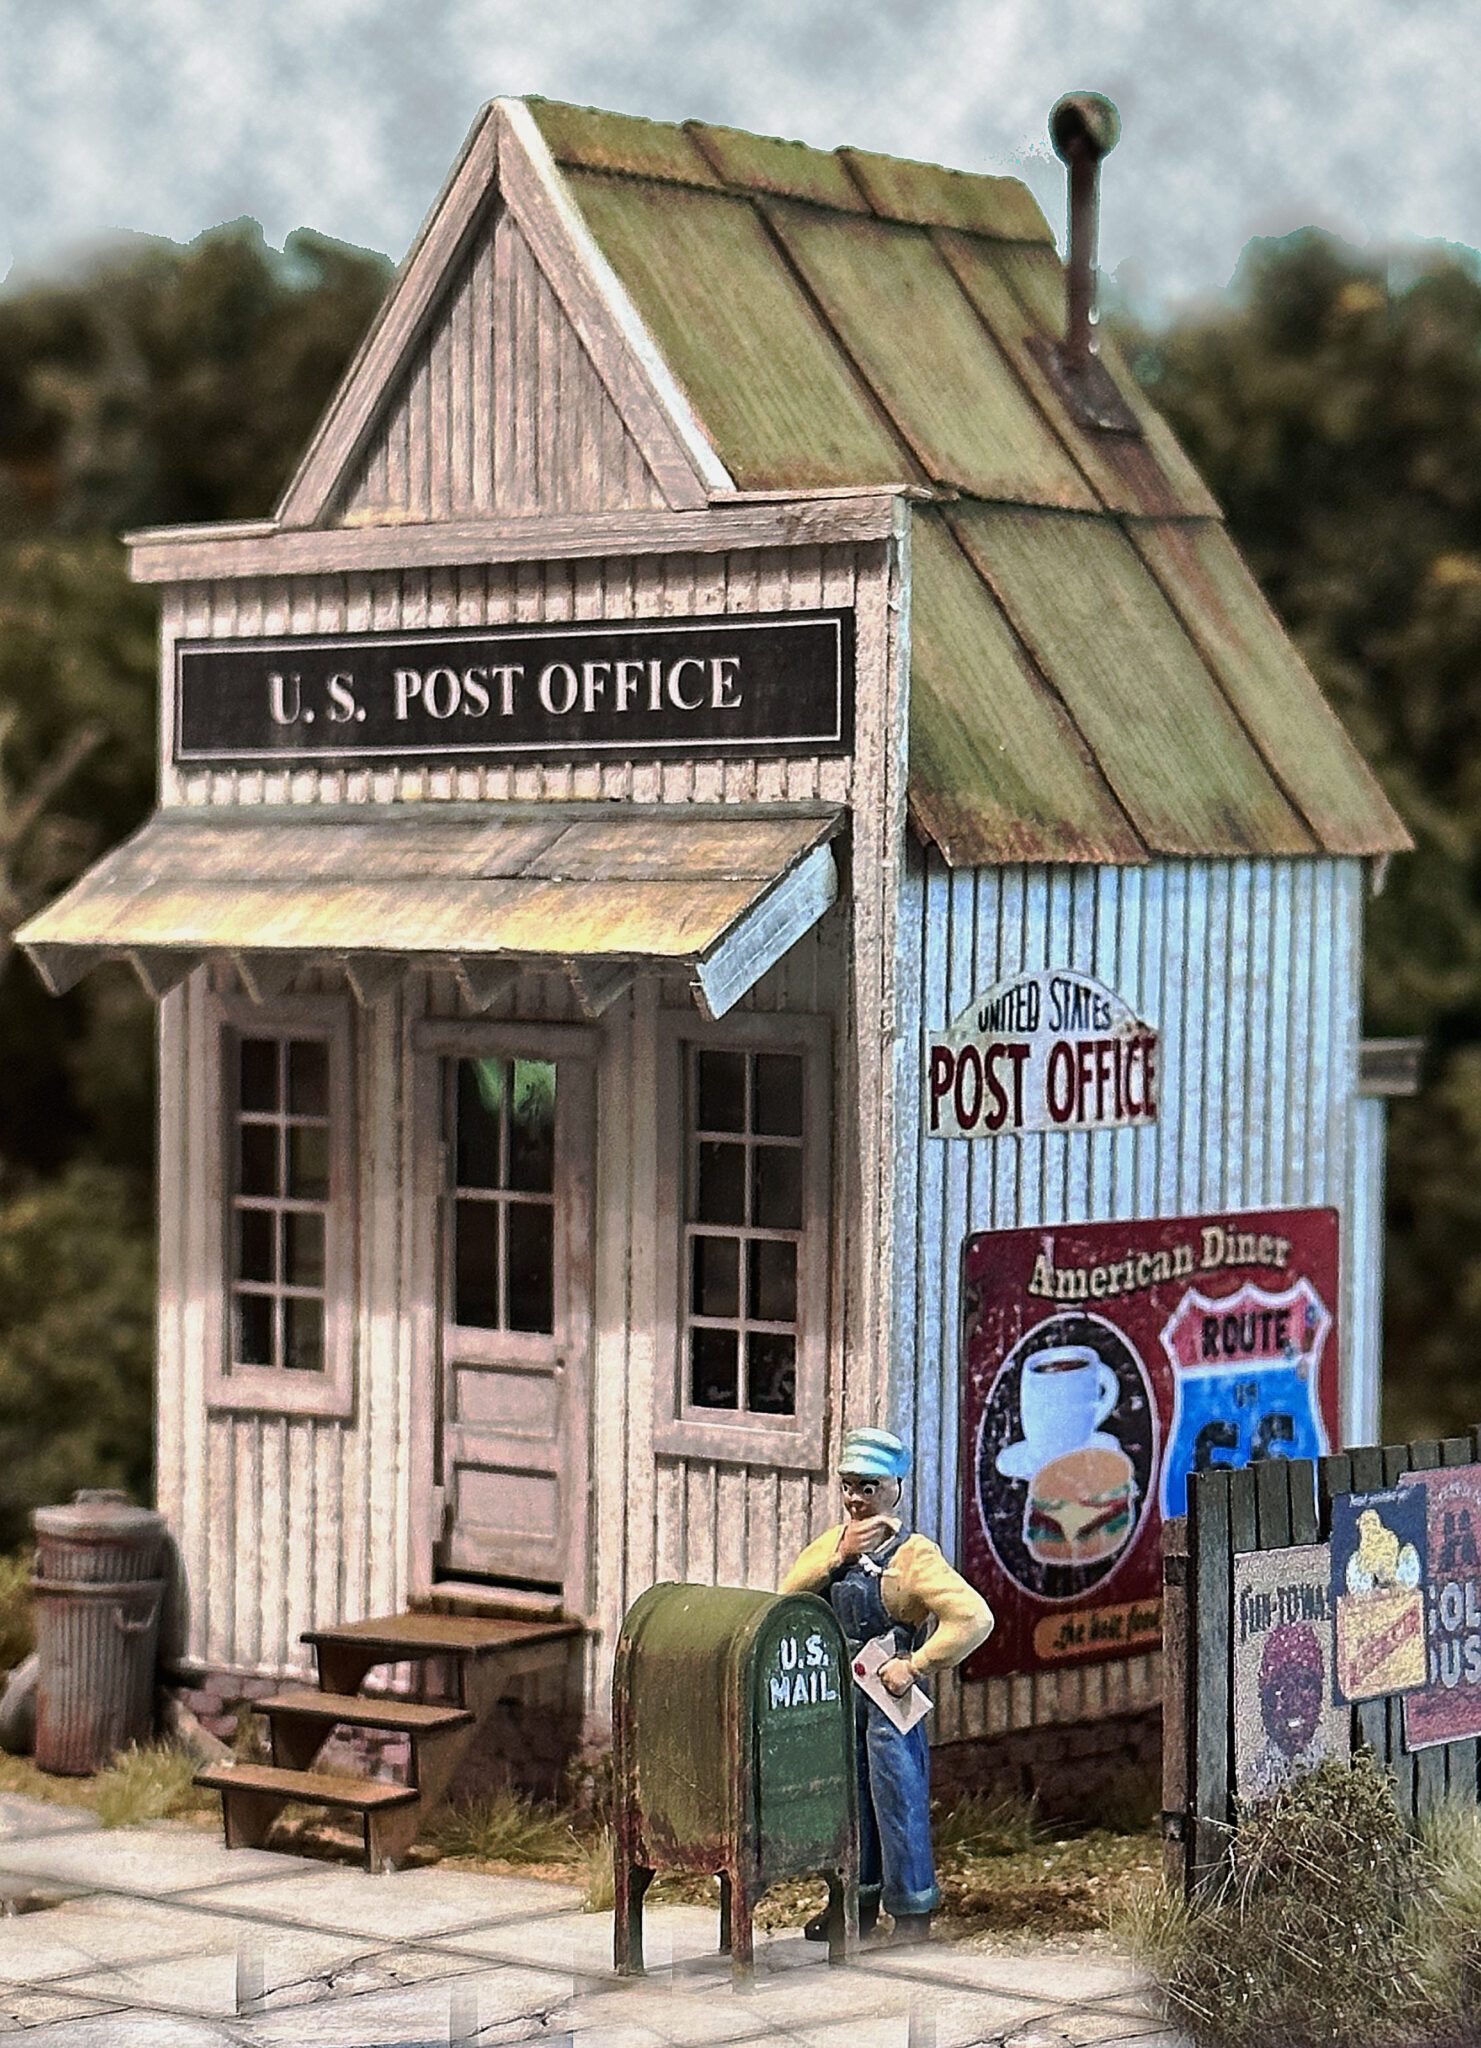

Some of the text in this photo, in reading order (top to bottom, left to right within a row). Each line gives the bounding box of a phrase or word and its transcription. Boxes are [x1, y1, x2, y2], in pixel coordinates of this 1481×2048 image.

[394, 665, 525, 721] POST
[538, 656, 743, 715] OFFICE
[978, 976, 1113, 1033] UNITED STATES
[930, 1034, 1159, 1131] POST OFFICE
[1028, 1224, 1292, 1299] American Diner
[1201, 1308, 1291, 1358] ROUTE
[780, 1633, 830, 1671] U.S.
[770, 1670, 837, 1710] MAIL
